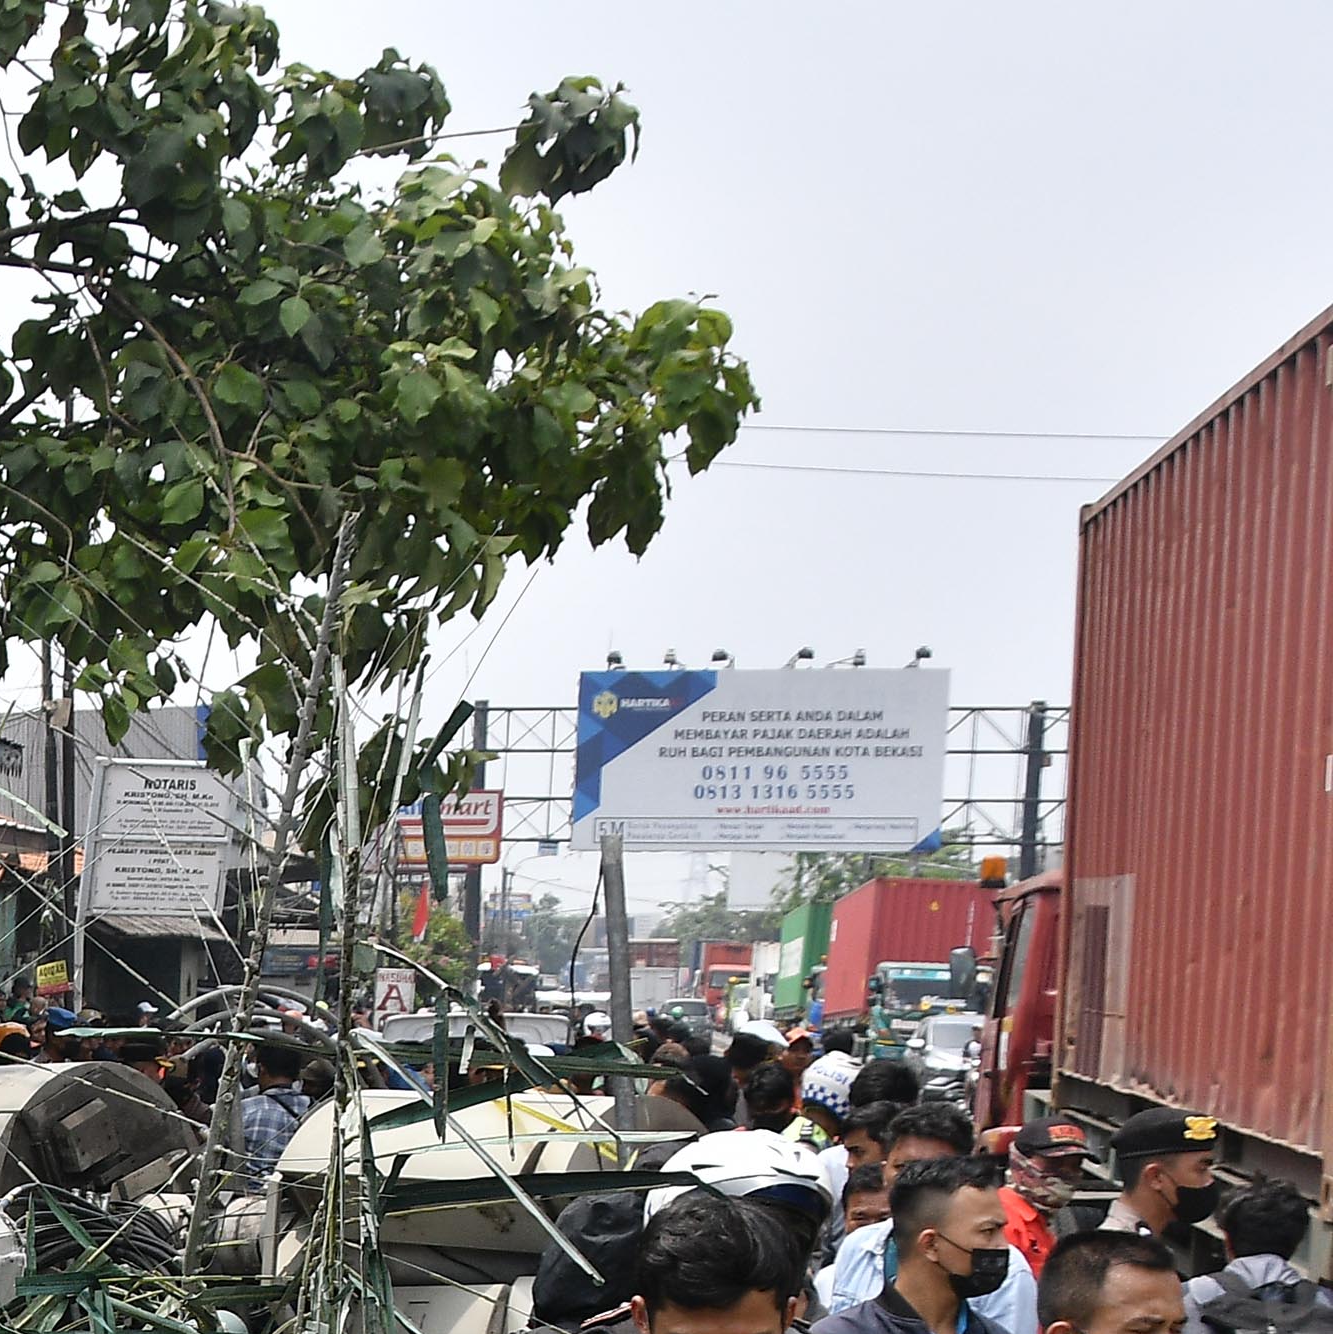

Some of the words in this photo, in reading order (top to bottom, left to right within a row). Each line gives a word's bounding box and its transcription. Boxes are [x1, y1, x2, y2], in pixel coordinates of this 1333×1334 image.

[620, 697, 670, 708] HARTIKA
[702, 711, 746, 722] PERAN
[750, 710, 792, 722] SERTA
[796, 710, 832, 721] ANDA
[836, 710, 883, 721] DALAM
[674, 729, 748, 740] MEMBAYAR
[753, 728, 794, 740] PAJAK
[798, 728, 852, 739] DAERAH
[855, 728, 910, 739] ADALAH
[658, 746, 687, 758] RUH
[691, 746, 724, 758] BAGI
[728, 746, 831, 758] PEMBANGUNAN
[835, 746, 871, 757] KOTA
[875, 746, 923, 757] BEKASI
[701, 765, 751, 780] 0811
[764, 765, 788, 780] 96
[801, 765, 848, 780] 5555
[144, 779, 197, 791] NOTARIS
[694, 784, 741, 799] 0813
[752, 784, 797, 799] 1316
[807, 783, 855, 799] 5555
[397, 799, 493, 817] Alfmart
